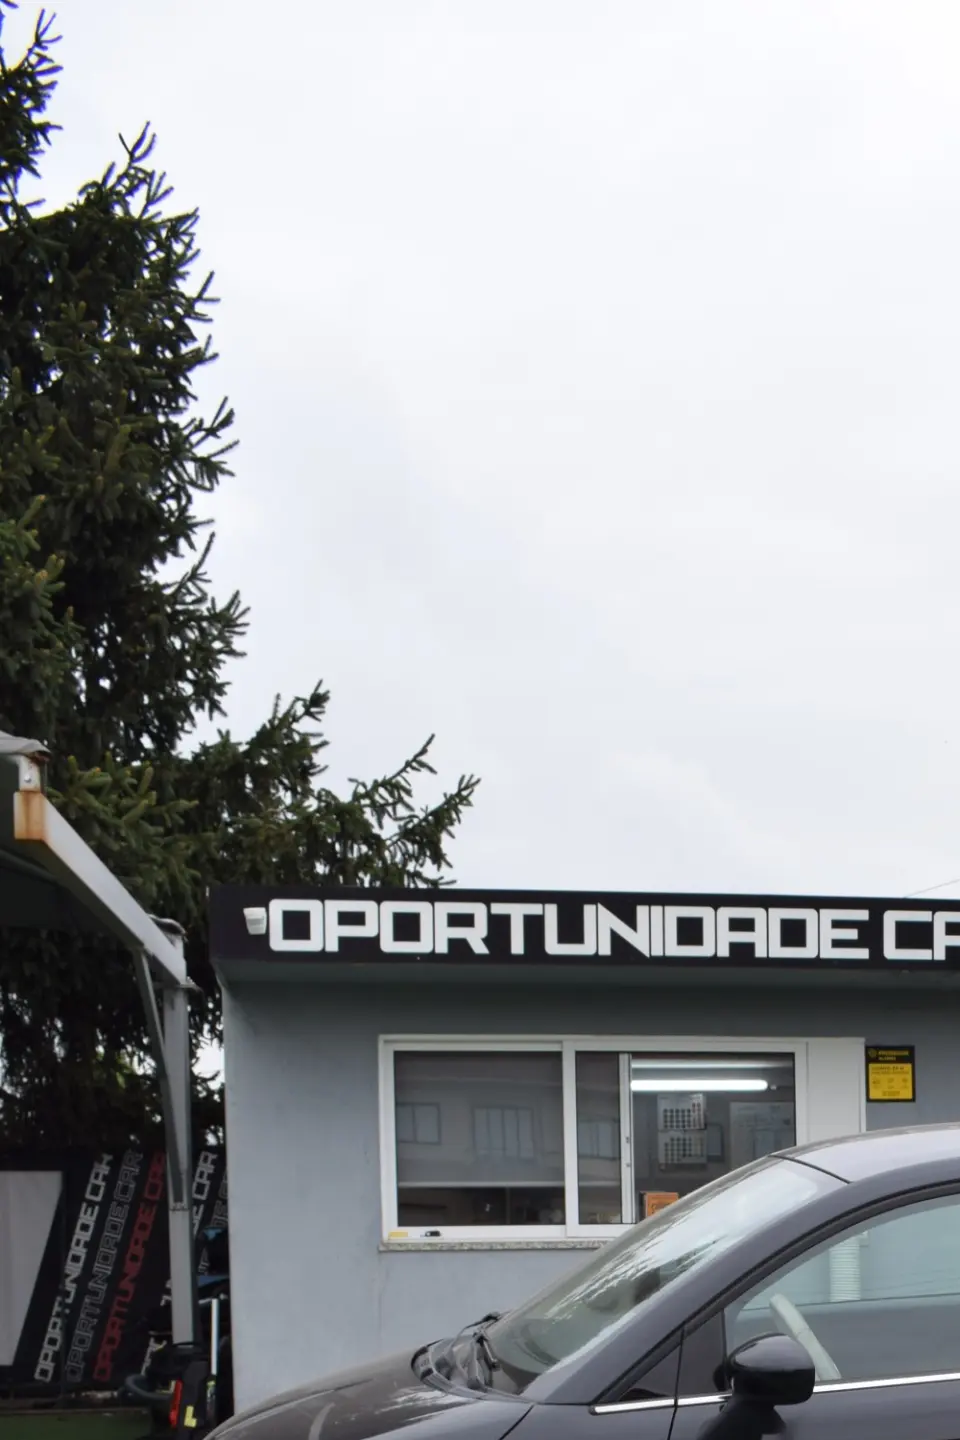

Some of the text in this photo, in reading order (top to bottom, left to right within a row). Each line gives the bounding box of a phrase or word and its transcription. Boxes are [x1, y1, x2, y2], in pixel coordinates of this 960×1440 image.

[268, 899, 869, 959] OPORTUNIDADE
[191, 1151, 218, 1201] CAR
[65, 1149, 144, 1382] OPORTUNIDADE CAR
